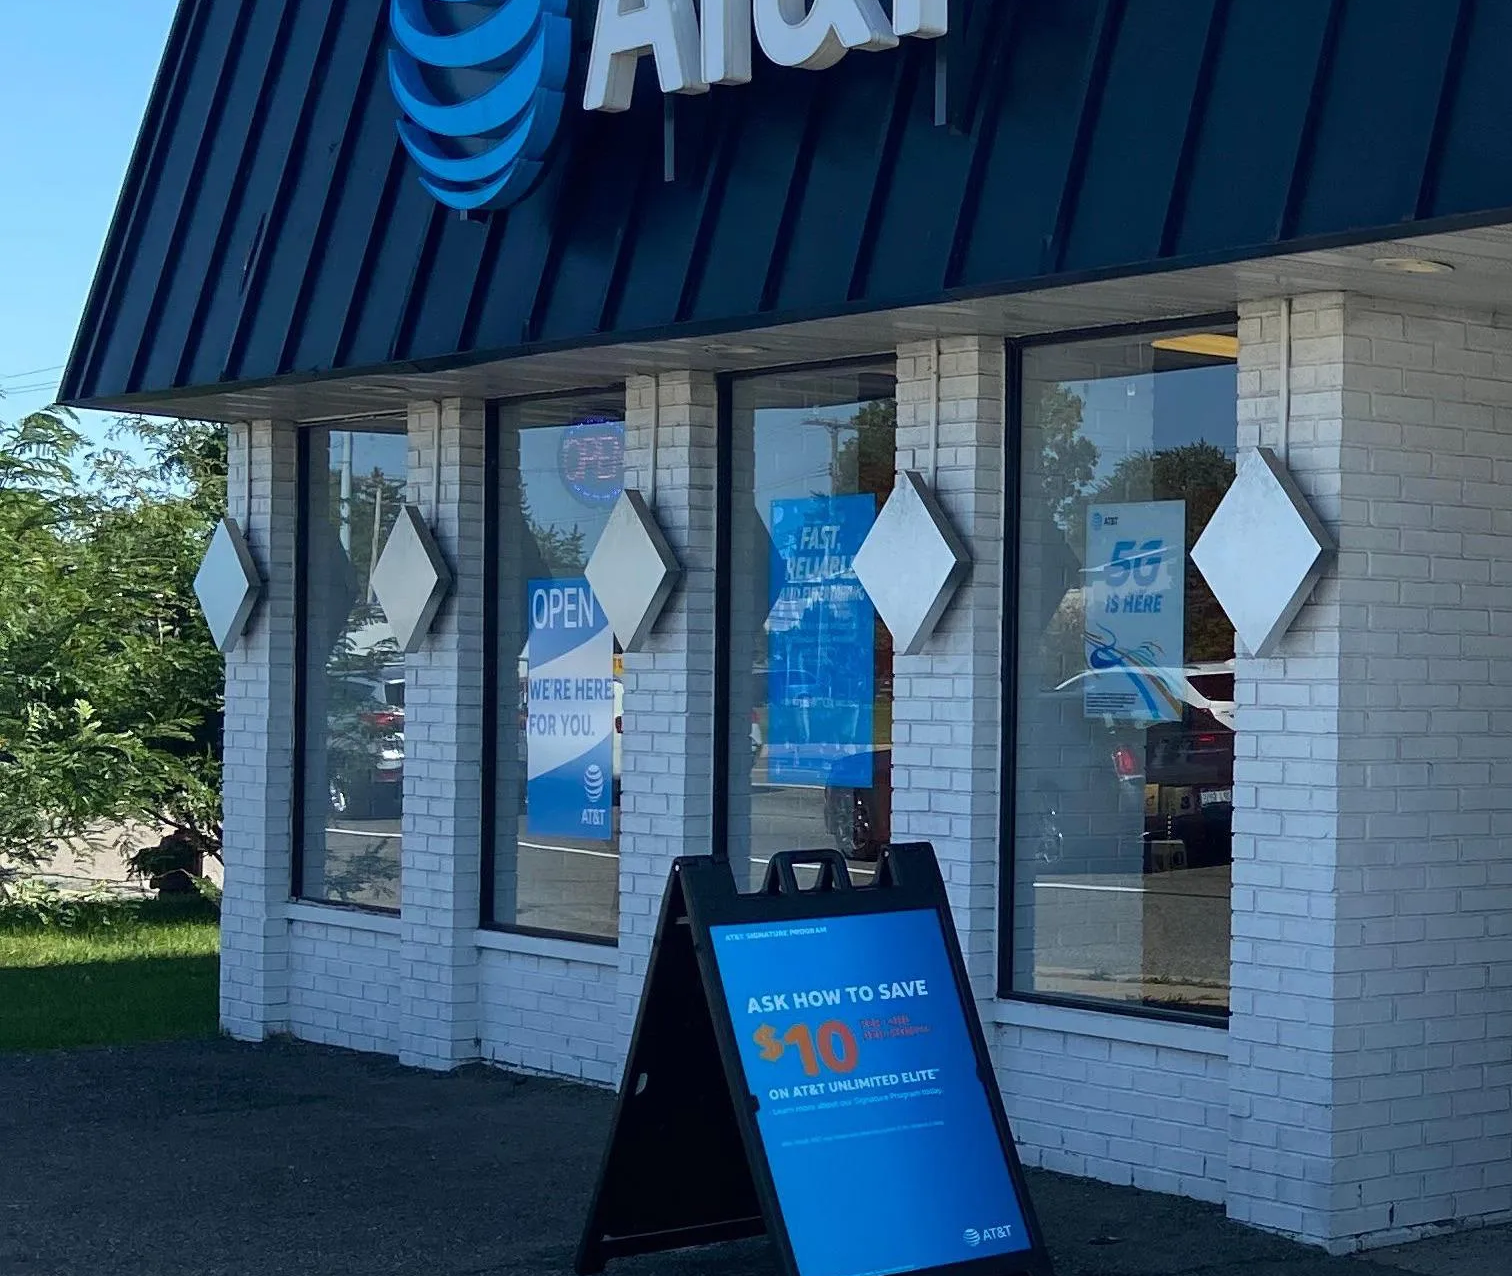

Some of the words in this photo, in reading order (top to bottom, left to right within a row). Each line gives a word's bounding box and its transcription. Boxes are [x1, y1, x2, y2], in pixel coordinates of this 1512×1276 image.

[1106, 539, 1163, 587] 5G
[532, 588, 594, 629] OPEN
[1105, 594, 1119, 614] IS
[1123, 593, 1163, 614] HERE
[530, 678, 571, 701] WE'RE
[529, 713, 556, 736] FOR
[560, 713, 595, 737] YOU.
[581, 808, 606, 825] AT&T
[746, 929, 788, 940] SIGNATURE
[789, 926, 827, 937] PROGRAM
[747, 994, 790, 1014] ASK
[793, 988, 841, 1009] HOW
[845, 985, 874, 1003] TO
[878, 979, 929, 1000] SAVE
[753, 1019, 859, 1077] $10
[768, 1088, 790, 1101] ON
[792, 1082, 826, 1099] AT&T
[828, 1074, 900, 1094] UNLIMITED
[983, 1225, 1012, 1242] AT&T
